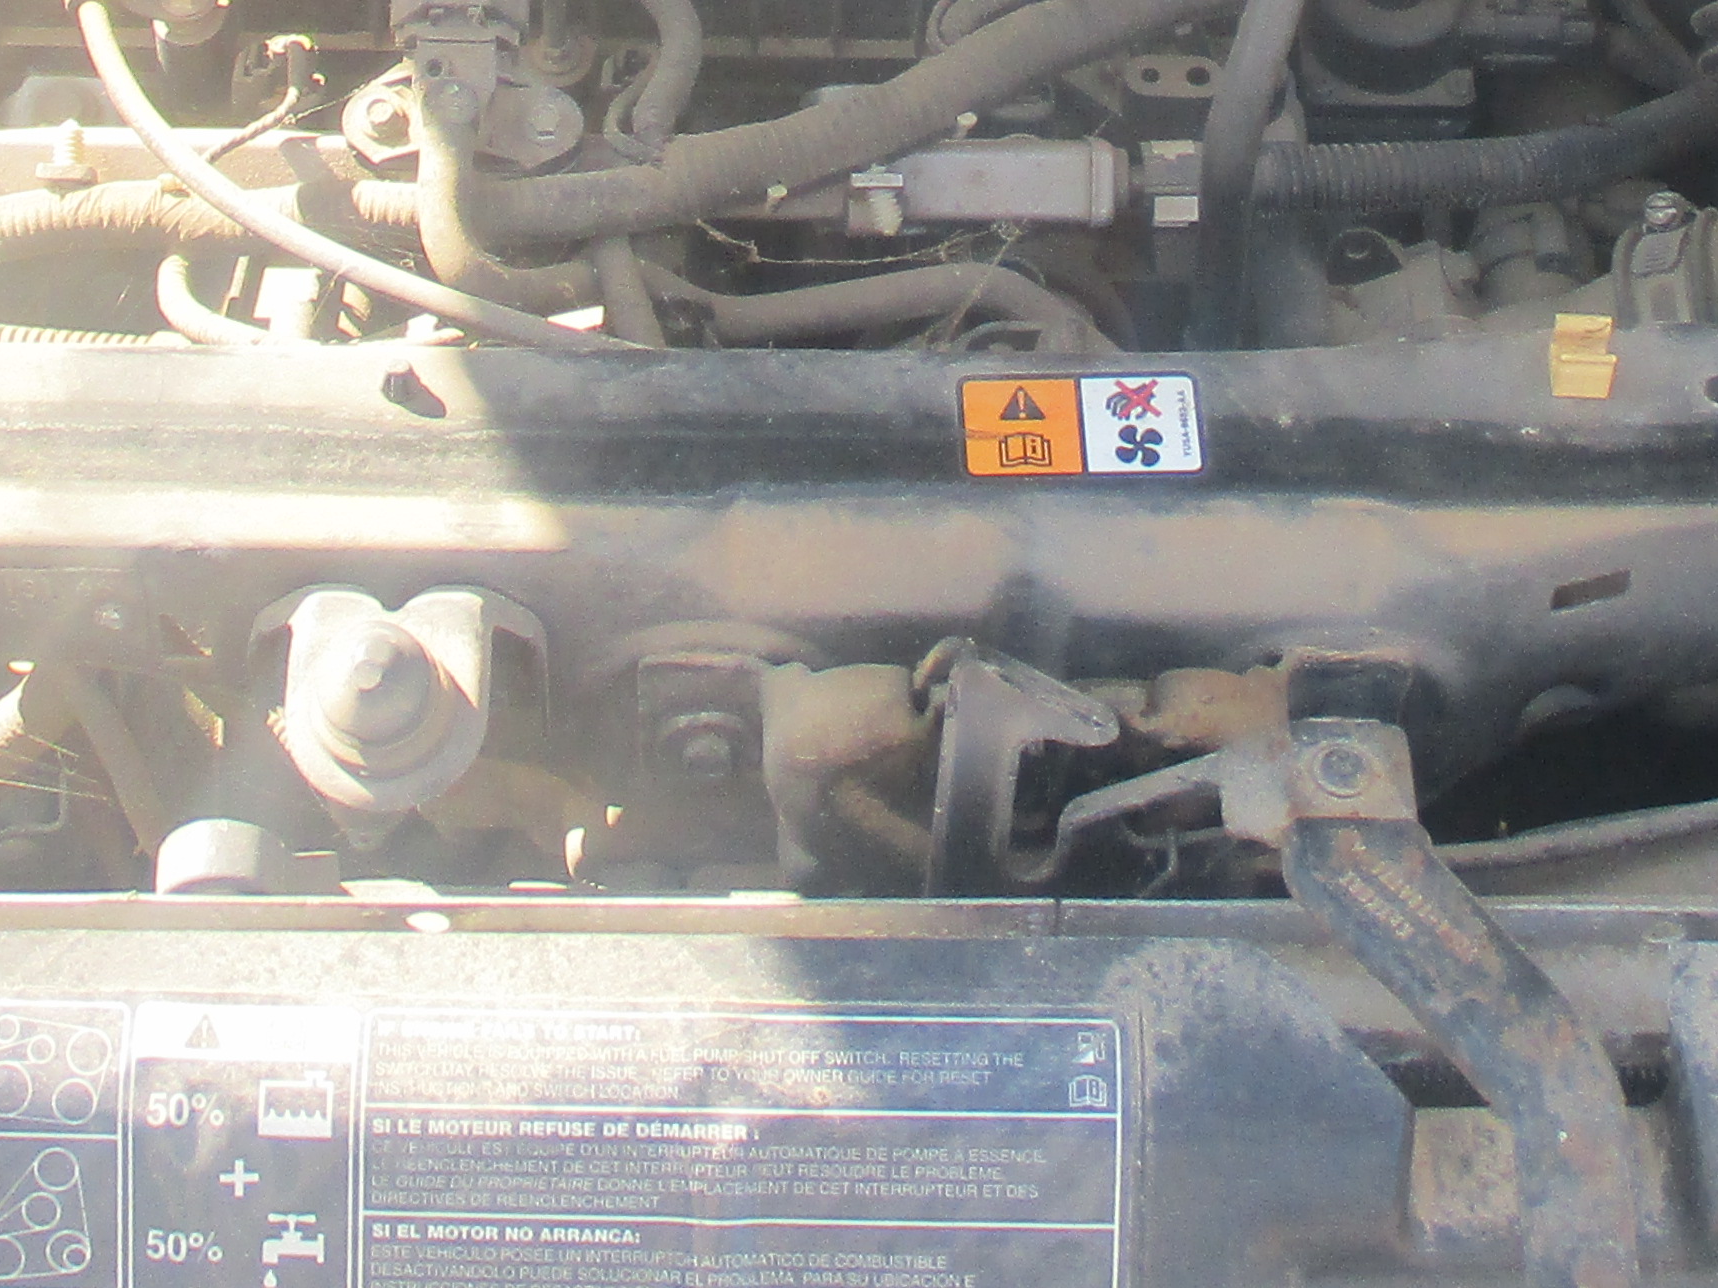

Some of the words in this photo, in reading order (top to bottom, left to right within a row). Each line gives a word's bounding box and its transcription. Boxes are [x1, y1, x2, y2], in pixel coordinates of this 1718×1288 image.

[544, 1024, 567, 1039] TO
[573, 1024, 641, 1041] START:
[377, 1041, 413, 1057] THIS
[417, 1042, 482, 1059] VEHICLE
[592, 1046, 633, 1062] WITH
[651, 1047, 691, 1063] FUEL
[744, 1049, 782, 1064] SHUT
[788, 1049, 820, 1065] OFF
[899, 1051, 989, 1067] RESETTING
[994, 1051, 1025, 1067] THE
[375, 1061, 432, 1076] SWITCH
[434, 1062, 473, 1077] MAY
[479, 1063, 549, 1078] RESOLVE
[556, 1064, 586, 1079] THE
[651, 1066, 704, 1081] REFER
[709, 1066, 729, 1081] TO
[736, 1067, 779, 1082] YOUR
[783, 1068, 843, 1084] OWNER
[901, 1070, 933, 1085] FOR
[940, 1071, 992, 1085] RESET
[497, 1081, 529, 1097] AND
[145, 1091, 226, 1126] 50%
[372, 1119, 391, 1134] SI
[397, 1119, 421, 1135] LE
[428, 1119, 513, 1136] MOTEUR
[519, 1121, 595, 1137] REFUSE
[602, 1122, 629, 1138] DE
[635, 1120, 748, 1140] DÉMARRER
[749, 1146, 861, 1161] AUTOMATIQUE
[866, 1147, 888, 1161] DE
[893, 1148, 948, 1162] POMPE
[563, 1160, 584, 1173] DE
[588, 1161, 621, 1174] CET
[892, 1165, 910, 1179] LE
[371, 1175, 390, 1187] LE
[396, 1175, 447, 1188] GUIDE
[450, 1176, 473, 1189] DU
[597, 1178, 658, 1192] DONNE
[794, 1181, 815, 1195] DE
[819, 1181, 849, 1195] CET
[855, 1182, 978, 1198] INTERRUPTEUR
[983, 1184, 1003, 1198] ET
[1006, 1184, 1039, 1199] DES
[371, 1192, 466, 1206] DIRECTIVES
[471, 1192, 491, 1206] DE
[372, 1223, 391, 1238] SI
[397, 1223, 421, 1239] EL
[427, 1224, 499, 1240] MOTOR
[505, 1226, 533, 1241] NO
[539, 1226, 641, 1243] ARRANCA:
[145, 1229, 224, 1263] 50%
[370, 1245, 413, 1259] ESTE
[500, 1247, 555, 1262] POSEE
[558, 1249, 581, 1262] UN
[808, 1254, 830, 1269] DE
[834, 1254, 947, 1270] COMBUSTIBLE
[519, 1264, 573, 1280] PUEDE
[577, 1266, 681, 1284] SOLUCIONAR
[685, 1271, 704, 1286] EL
[802, 1271, 842, 1286] PARA
[846, 1273, 869, 1287] SU
[964, 1274, 976, 1288] E
